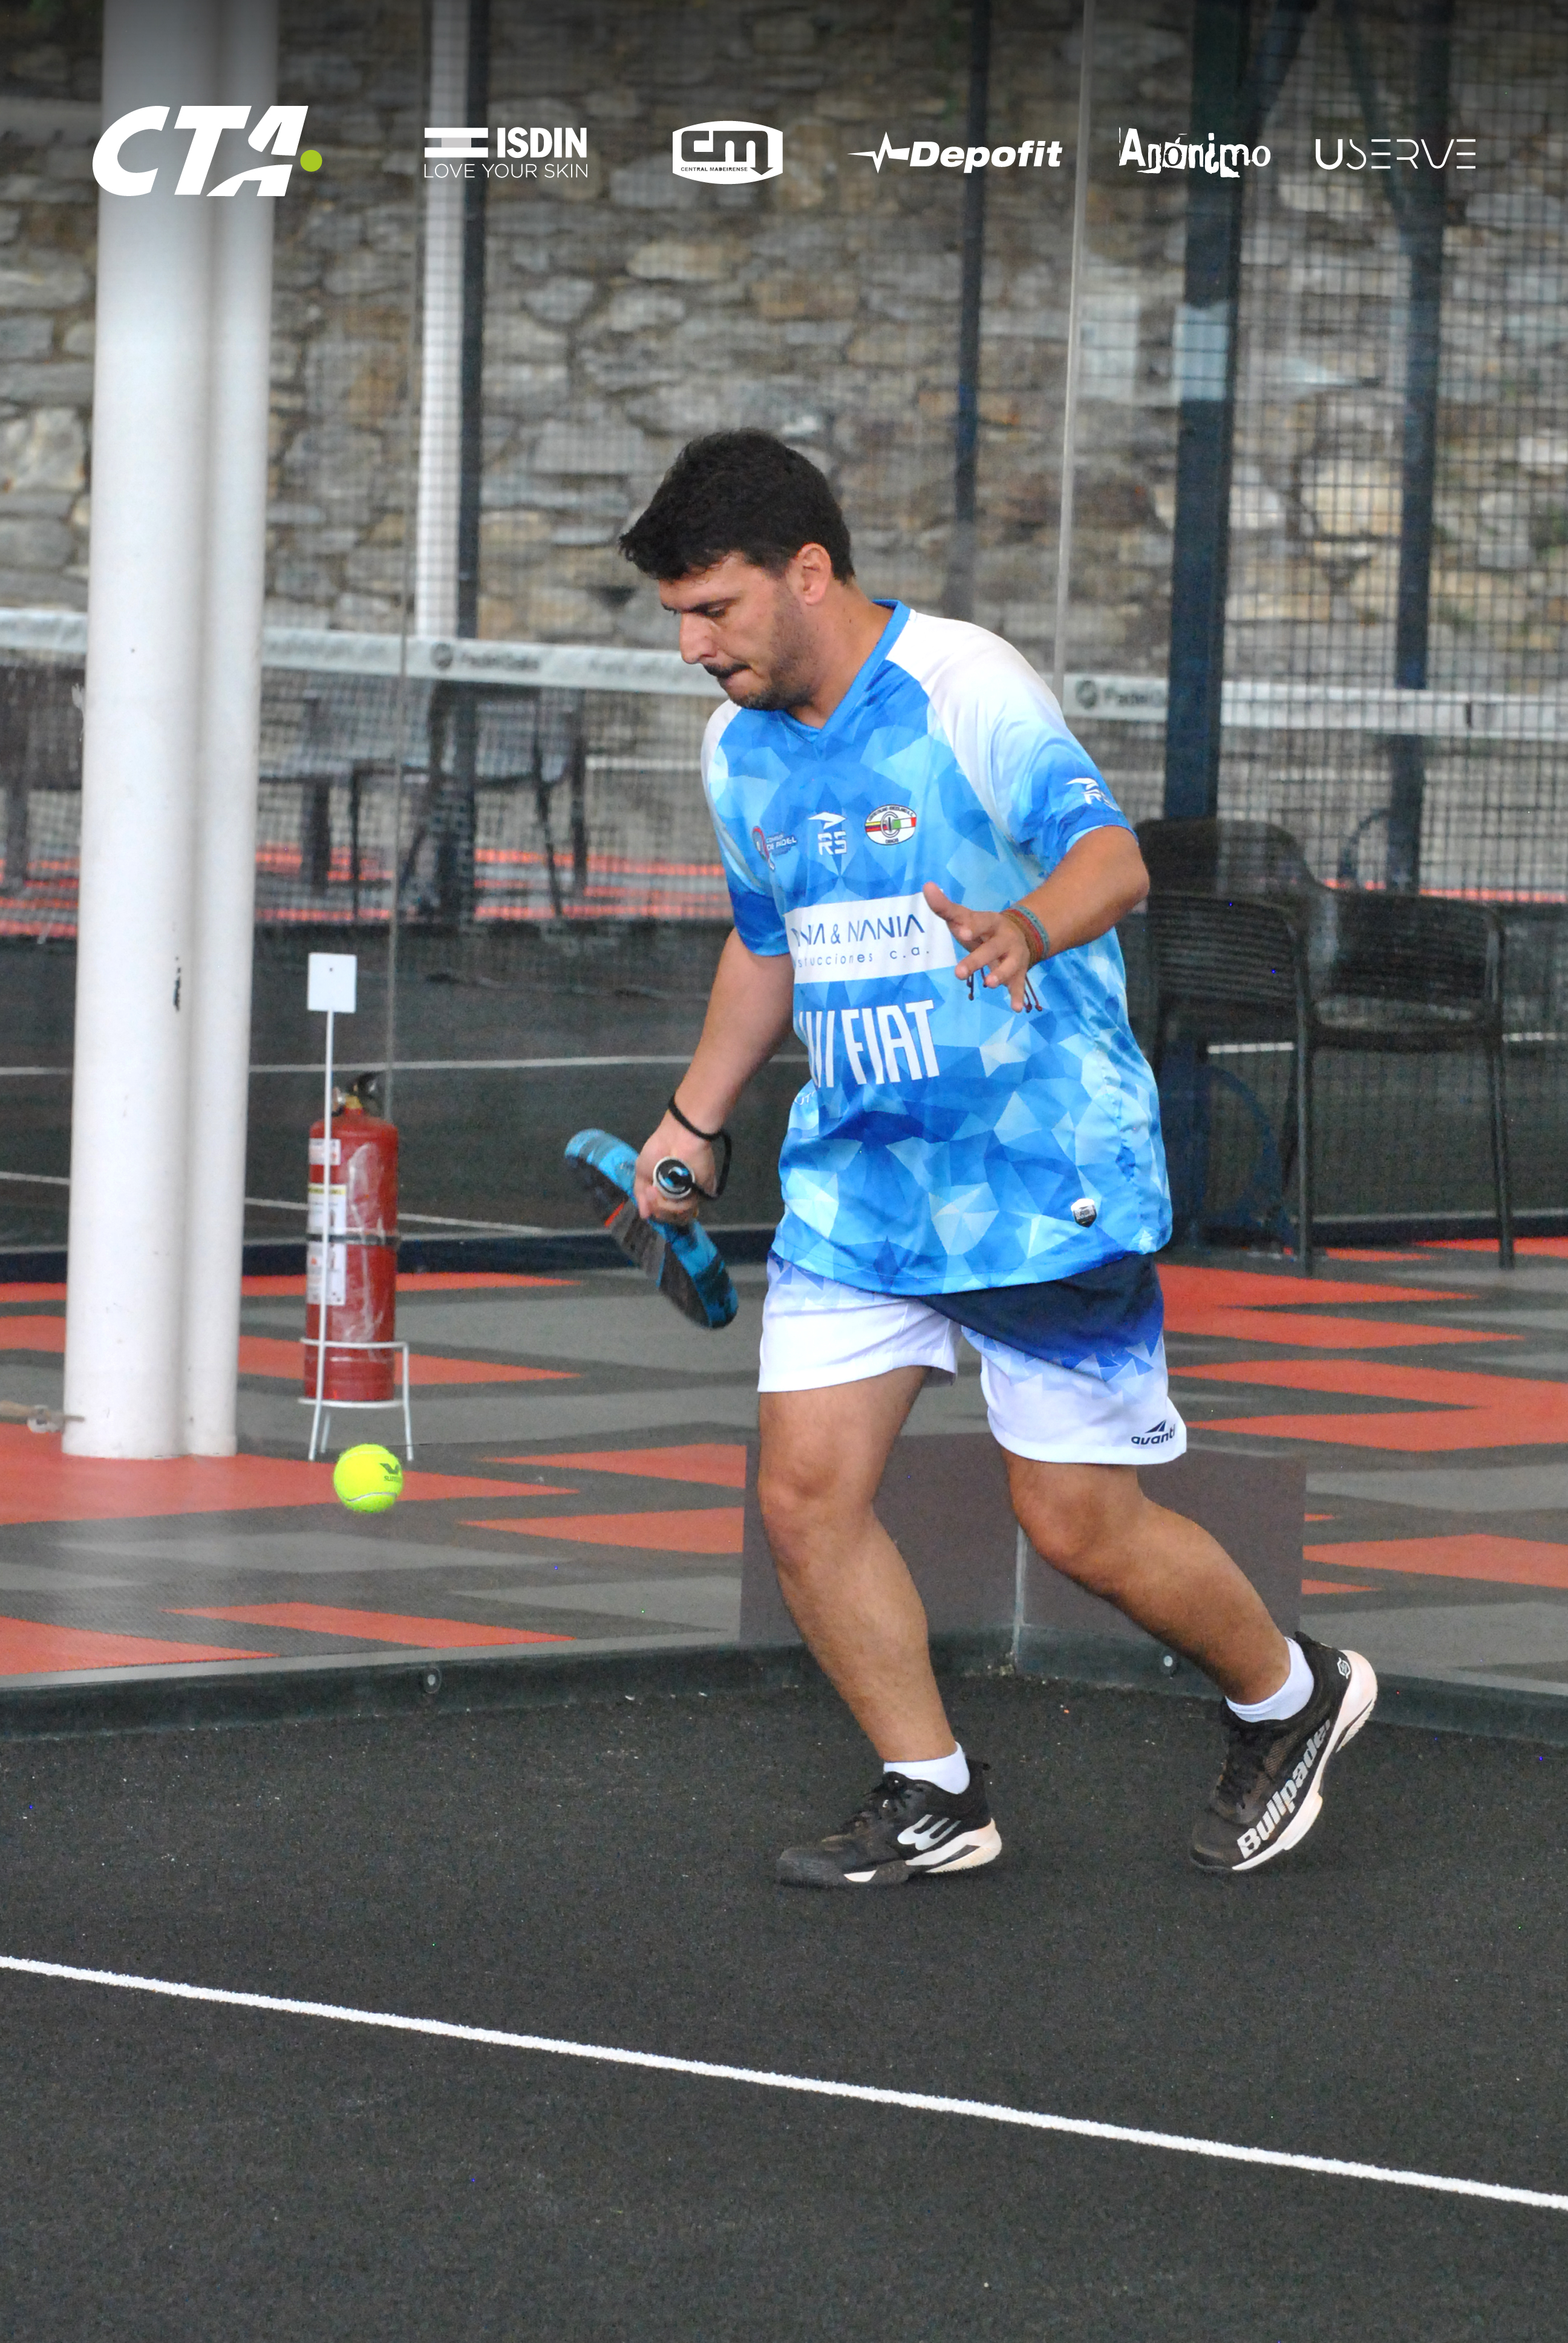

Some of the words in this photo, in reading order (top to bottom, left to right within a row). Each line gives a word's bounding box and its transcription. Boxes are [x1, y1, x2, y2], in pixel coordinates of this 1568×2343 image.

[831, 923, 841, 945] &
[848, 914, 925, 943] NANIA
[841, 999, 940, 1085] FIAT
